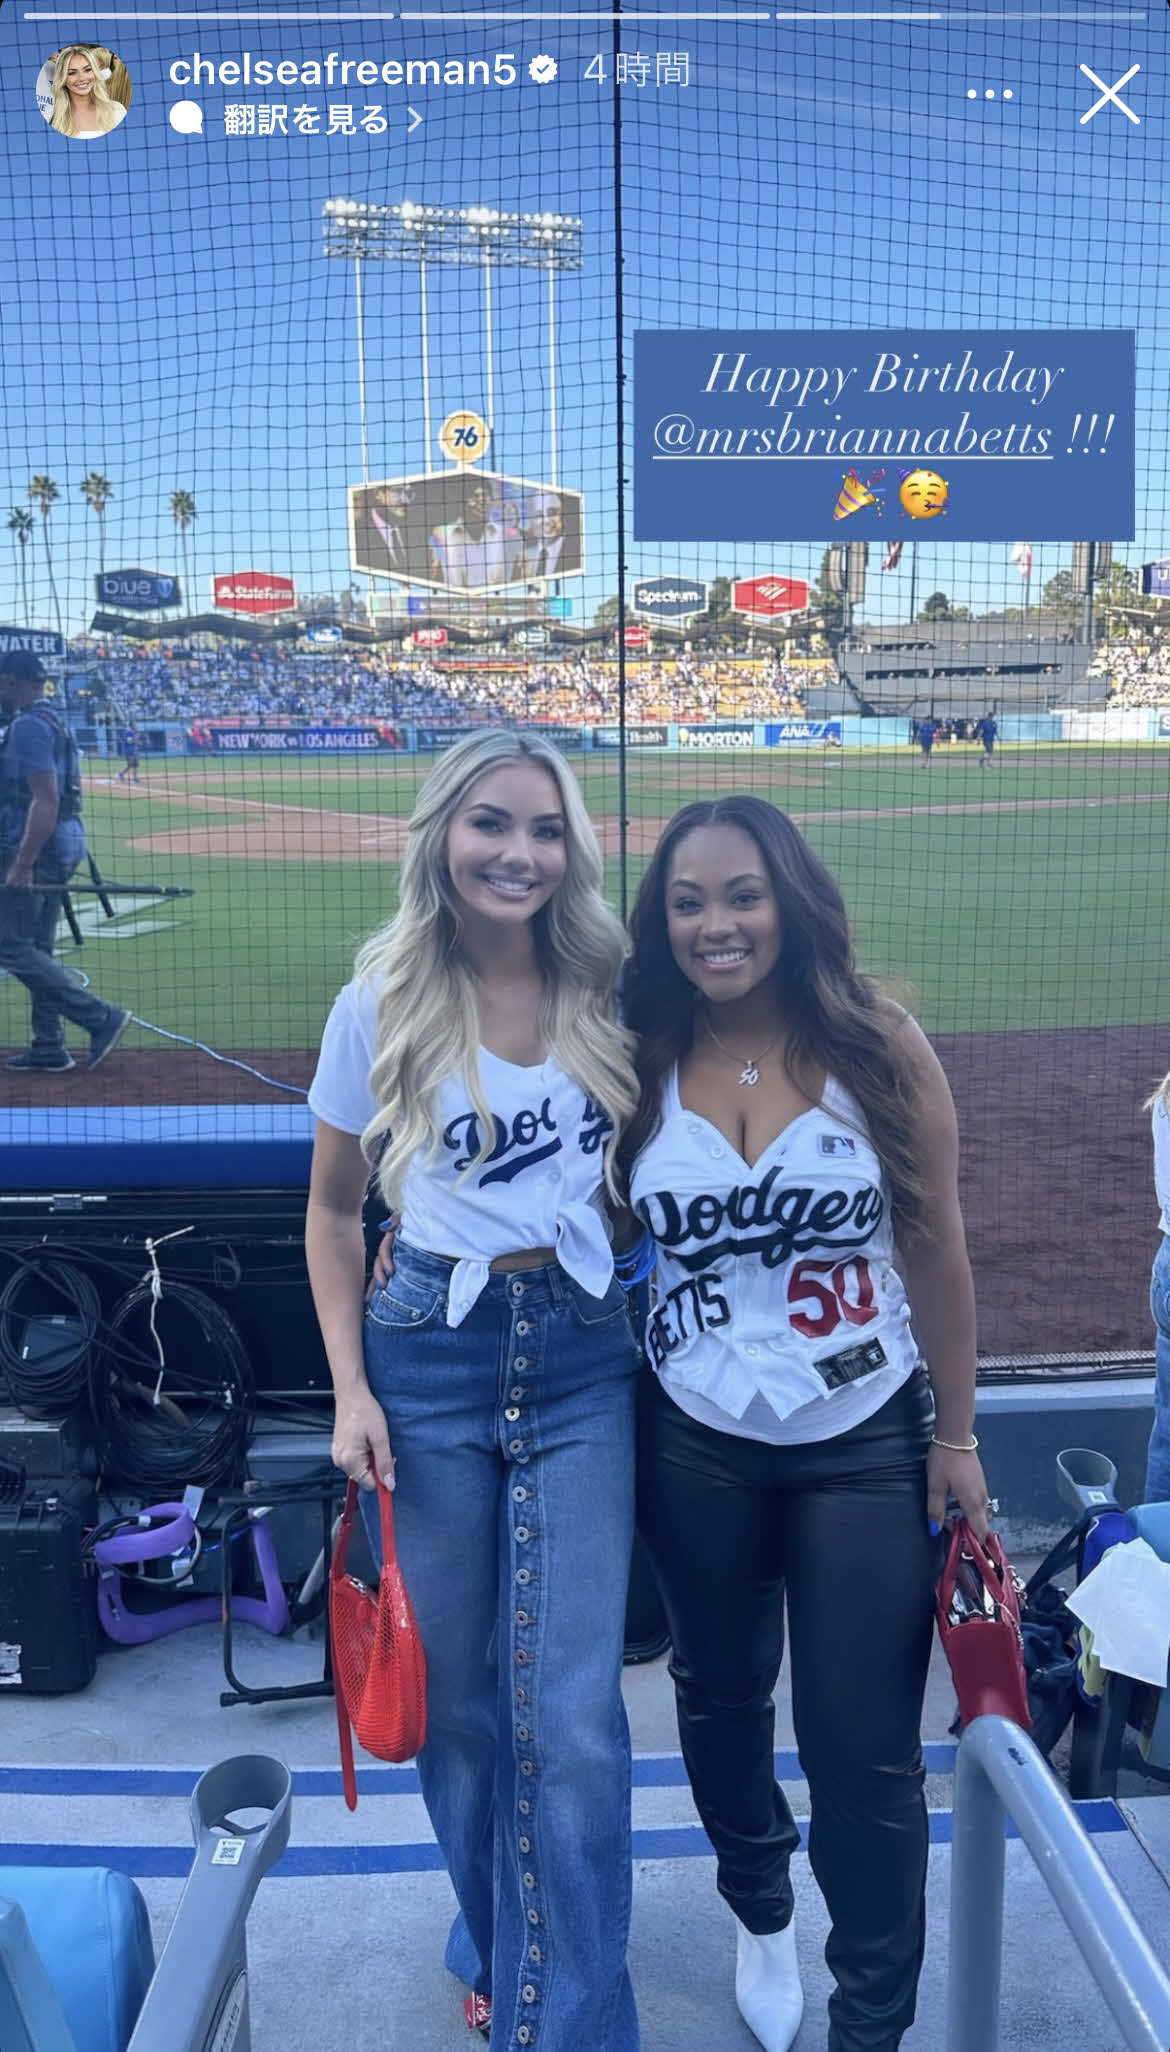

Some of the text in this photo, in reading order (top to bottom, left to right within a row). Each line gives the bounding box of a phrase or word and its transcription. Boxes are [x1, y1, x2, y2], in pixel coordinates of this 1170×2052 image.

[454, 426, 478, 447] 76
[103, 575, 151, 596] blue
[638, 589, 699, 606] Spectrum
[629, 731, 663, 744] Health
[779, 724, 809, 738] ANA
[218, 734, 249, 749] NEW
[250, 734, 286, 748] YORK
[301, 734, 323, 748] LOS
[324, 733, 379, 748] ANGELES
[689, 732, 754, 747] MORTON
[787, 1254, 880, 1340] 50
